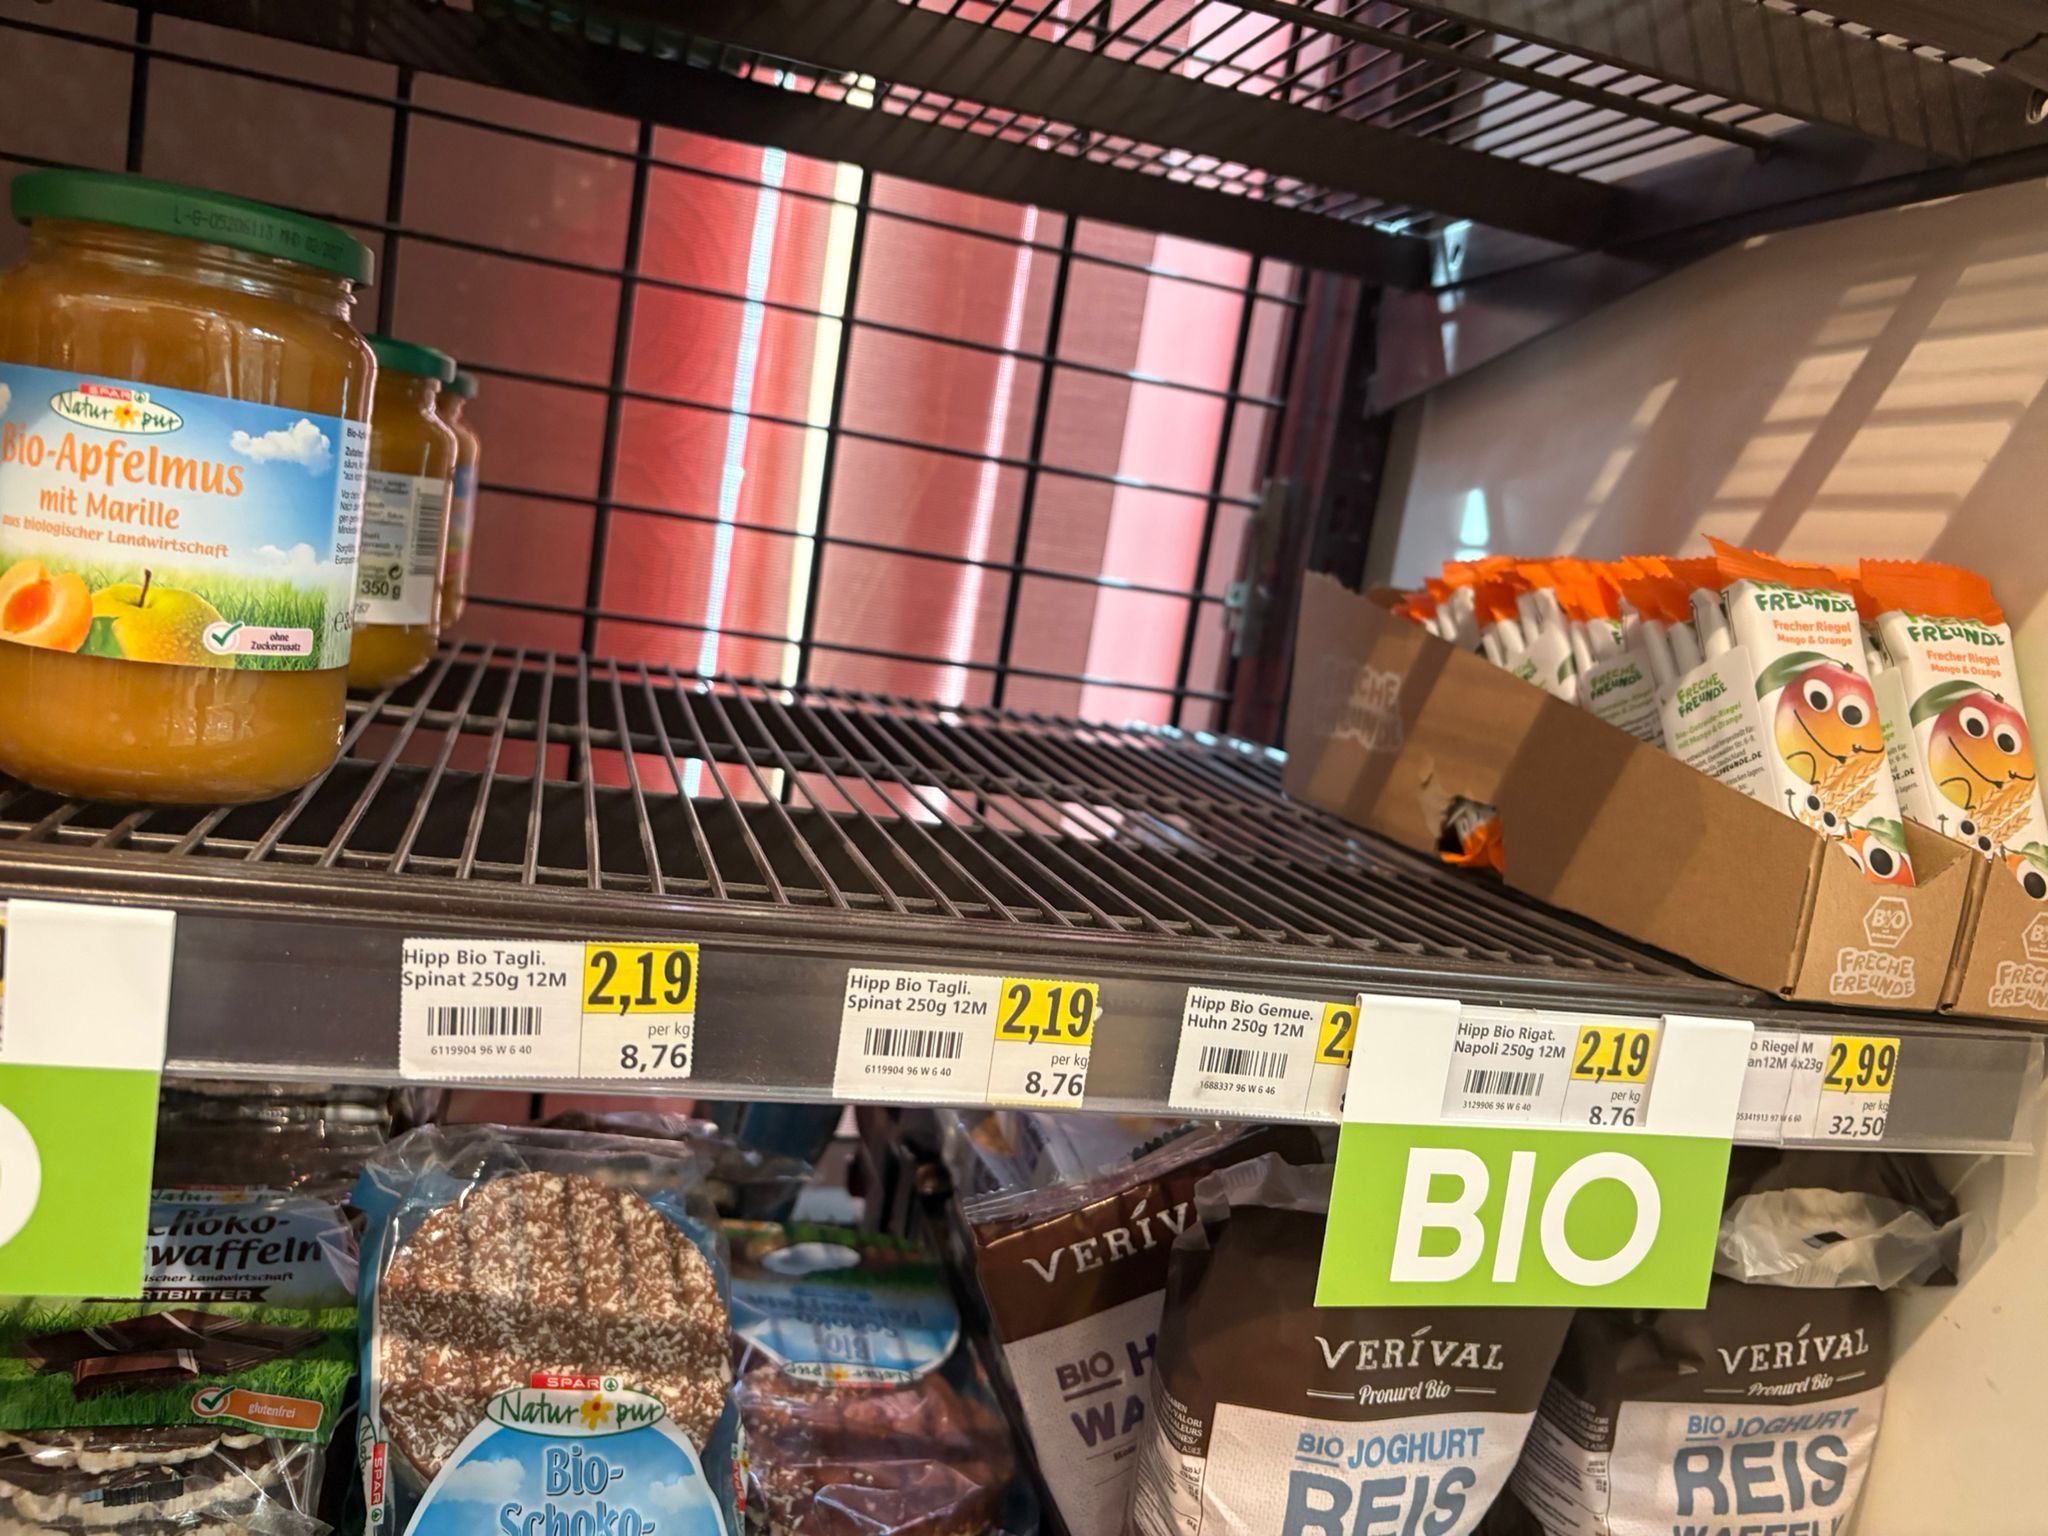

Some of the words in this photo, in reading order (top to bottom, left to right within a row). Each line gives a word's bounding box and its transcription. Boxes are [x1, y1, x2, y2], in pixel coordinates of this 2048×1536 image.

[89, 386, 131, 401] SPAR
[57, 391, 113, 420] Natur
[141, 411, 180, 430] pur
[2, 421, 245, 497] Bio-Apfelmus
[40, 486, 78, 515] mit
[86, 491, 181, 530] Marille
[23, 516, 104, 541] biologischer
[107, 531, 230, 558] Landwirtschaft
[361, 579, 389, 597] 350
[392, 585, 402, 601] g
[1754, 593, 1857, 614] FREUNDE
[269, 631, 290, 642] ohne
[1773, 619, 1812, 633] Frecher
[1815, 621, 1851, 637] Riegel
[1907, 625, 2006, 647] FREUNDE
[250, 641, 302, 652] Zuckerzusatz
[1777, 634, 1806, 646] Mango
[1807, 635, 1816, 645] &
[1817, 635, 1853, 648] Orange
[1926, 650, 1967, 664] Frecher
[1968, 652, 2000, 667] Riegel
[1930, 663, 1962, 675] Mango
[1962, 665, 1970, 675] &
[1971, 666, 2002, 680] Orange
[1676, 671, 1722, 705] FRECHE
[1678, 682, 1728, 719] FREUNDE
[403, 949, 450, 968] Hipp
[457, 950, 487, 965] Bio
[493, 950, 546, 969] Tagli.
[1840, 950, 1913, 977] FRECHE
[403, 971, 466, 990] Spinat
[472, 972, 519, 990] 250g
[528, 972, 568, 987] 12M
[587, 950, 691, 1016] 2,19
[850, 974, 890, 994] Hipp
[895, 977, 922, 992] Bio
[927, 979, 972, 997] Tagli.
[1832, 974, 1915, 997] FREUNDE
[847, 995, 902, 1012] Spinat
[906, 998, 947, 1017] 250g
[954, 1000, 988, 1016] 12M
[1002, 984, 1094, 1045] 2,19
[1190, 995, 1226, 1014] Hipp
[1230, 999, 1254, 1015] Bio
[1258, 1002, 1314, 1022] Gemue.
[648, 1024, 672, 1039] per
[675, 1022, 691, 1039] kg
[1187, 1014, 1228, 1031] Huhn
[1231, 1018, 1268, 1037] 250g
[1274, 1022, 1305, 1038] 12M
[1457, 1023, 1491, 1041] Hipp
[1494, 1026, 1516, 1039] Bio
[1521, 1026, 1556, 1043] Rigat.
[431, 1045, 477, 1056] 6119904
[480, 1045, 493, 1055] 96
[496, 1045, 507, 1055] W
[509, 1045, 516, 1055] 6
[518, 1045, 532, 1055] 40
[620, 1044, 688, 1073] 8,76
[1454, 1040, 1499, 1057] Napoli
[1501, 1043, 1535, 1060] 250g
[1538, 1045, 1566, 1060] 12M
[1574, 1030, 1650, 1084] 2,19
[1761, 1040, 1799, 1056] Riegel
[1801, 1042, 1814, 1054] M
[864, 1064, 904, 1076] 6119904
[907, 1066, 918, 1076] 96
[920, 1066, 931, 1076] W
[932, 1067, 938, 1077] 6
[940, 1067, 952, 1077] 40
[1050, 1055, 1072, 1068] per
[1073, 1053, 1089, 1070] kg
[1790, 1057, 1824, 1073] 4x23g
[1824, 1042, 1896, 1095] 2,99
[1024, 1071, 1084, 1098] 8,76
[1200, 1081, 1234, 1092] 1688337
[1236, 1083, 1246, 1093] 96
[1248, 1085, 1257, 1093] W
[1258, 1085, 1264, 1094] 6
[1265, 1086, 1275, 1095] 46
[1463, 1100, 1494, 1110] 3129906
[1495, 1101, 1505, 1111] 96
[1506, 1102, 1515, 1111] W
[1515, 1102, 1521, 1111] 6
[1521, 1103, 1532, 1112] 40
[1611, 1091, 1627, 1103] per
[1629, 1090, 1641, 1105] kg
[1862, 1100, 1877, 1112] per
[1878, 1099, 1889, 1113] kg
[1828, 1115, 1885, 1138] 32,50
[1389, 1147, 1662, 1287] BIO
[1022, 1198, 1191, 1284] VERÍV
[151, 1237, 322, 1270] waffeln
[189, 1272, 294, 1282] Landwirtschaft
[1313, 1325, 1504, 1372] VERÍVAL
[1717, 1322, 1869, 1376] VERÍVAL
[1055, 1350, 1115, 1392] BIO
[1811, 1372, 1834, 1391] Bio
[546, 1377, 600, 1389] SPAR
[1425, 1379, 1451, 1399] Bio
[247, 1401, 296, 1419] glutenfrei
[500, 1394, 579, 1425] Natur
[615, 1402, 661, 1429] pur
[1687, 1415, 1726, 1436] BIO
[1726, 1407, 1860, 1439] JOGHURT
[1297, 1433, 1344, 1458] BIO
[1348, 1427, 1485, 1470] JOGHURT
[373, 1457, 384, 1505] SPAR
[545, 1444, 624, 1496] Bio-
[1673, 1435, 1849, 1517] REIS
[1282, 1467, 1478, 1536] REIS
[499, 1500, 656, 1536] Schoko-
